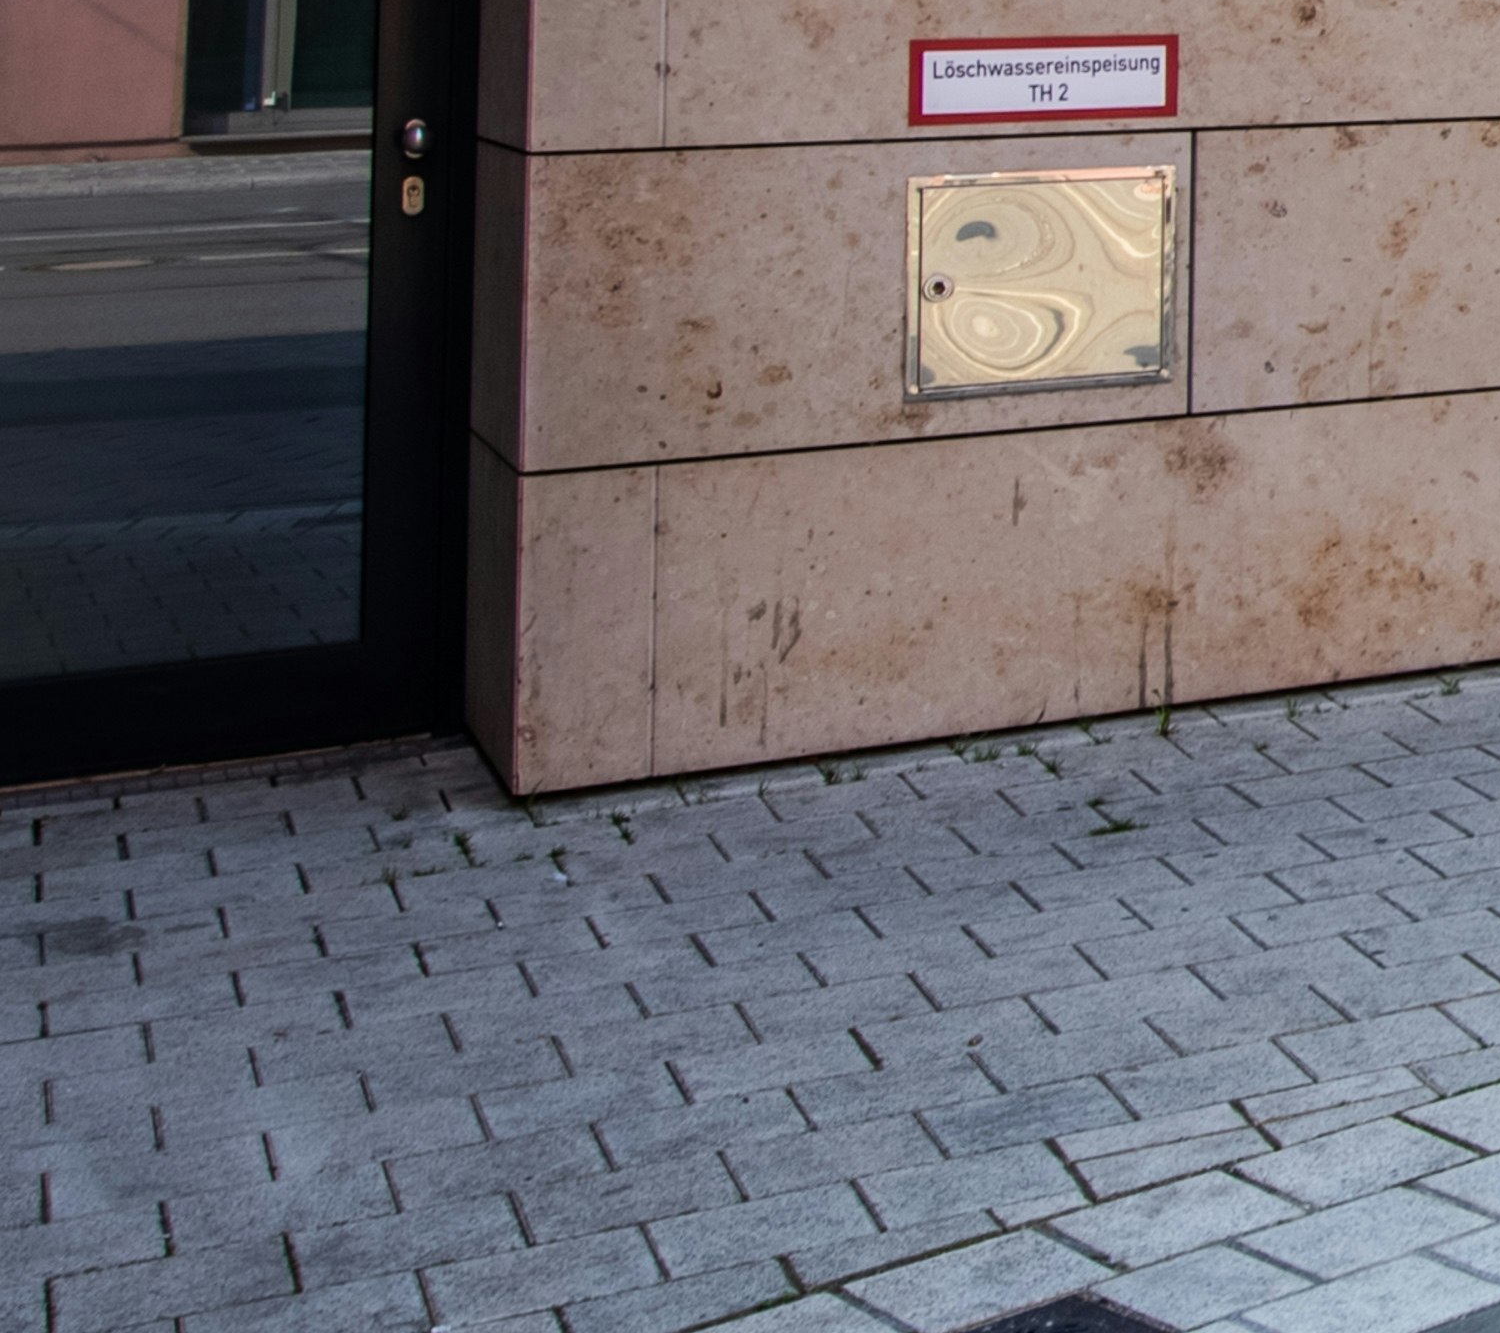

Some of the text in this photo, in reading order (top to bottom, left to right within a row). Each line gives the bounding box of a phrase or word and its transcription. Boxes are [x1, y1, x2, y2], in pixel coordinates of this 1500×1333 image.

[932, 53, 1161, 80] Löschwassereinspeisung
[1028, 83, 1069, 103] TH 2
